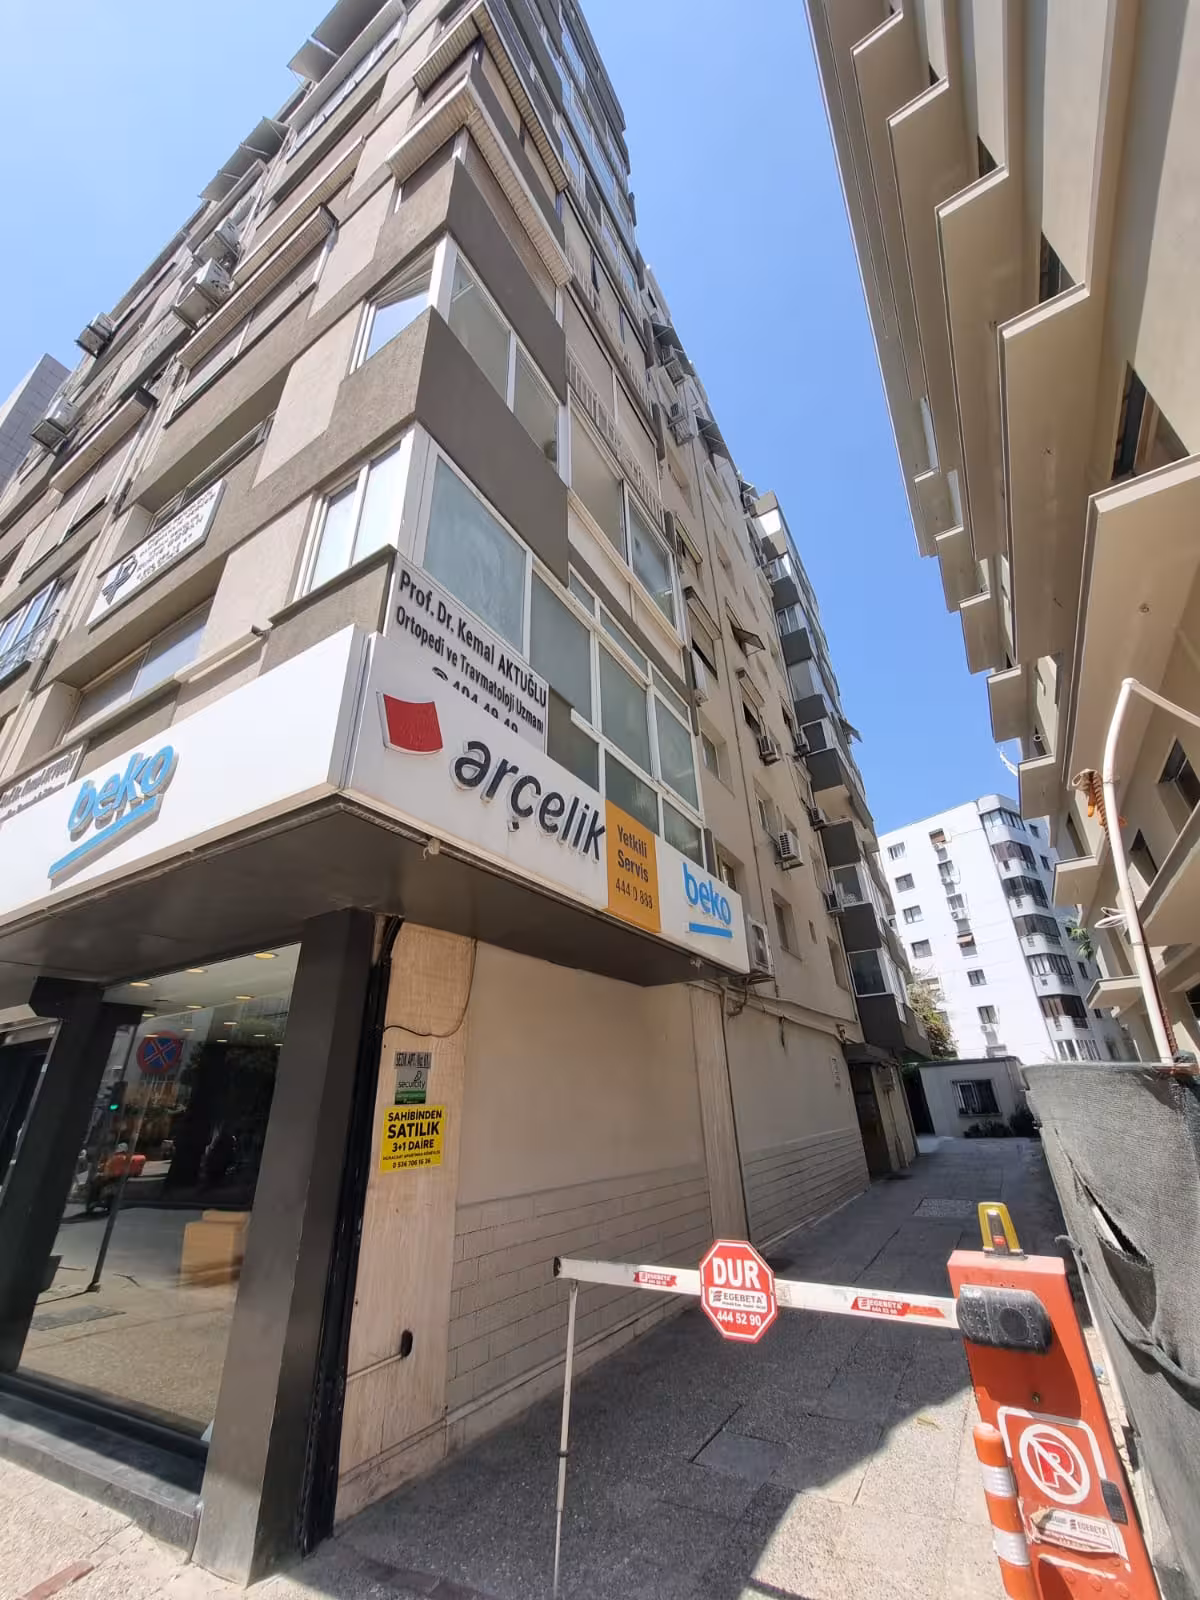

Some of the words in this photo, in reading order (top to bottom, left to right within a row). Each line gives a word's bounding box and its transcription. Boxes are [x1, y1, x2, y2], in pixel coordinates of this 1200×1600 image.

[399, 570, 434, 617] Prof.
[437, 601, 454, 633] Dr.
[457, 617, 495, 665] Kemal
[498, 653, 547, 708] AKTUĞLU
[396, 606, 445, 657] Ortopedi
[446, 646, 458, 667] ve
[460, 653, 515, 713] Travmatoloji
[516, 696, 545, 735] Uzmanı
[67, 745, 177, 836] beko
[453, 740, 606, 862] arçelik
[617, 824, 648, 859] Yetkili
[617, 849, 649, 883] Servis
[615, 878, 631, 897] 444
[682, 861, 732, 926] beko
[387, 1121, 440, 1139] SATILIK
[388, 1109, 442, 1122] SAHİBİNDEN
[391, 1141, 407, 1153] 3+1
[408, 1137, 435, 1150] DAİRE
[712, 1257, 761, 1289] DUR
[723, 1292, 763, 1305] EGEBETA
[717, 1310, 734, 1323] 444
[735, 1312, 748, 1325] 52
[749, 1314, 762, 1327] 90
